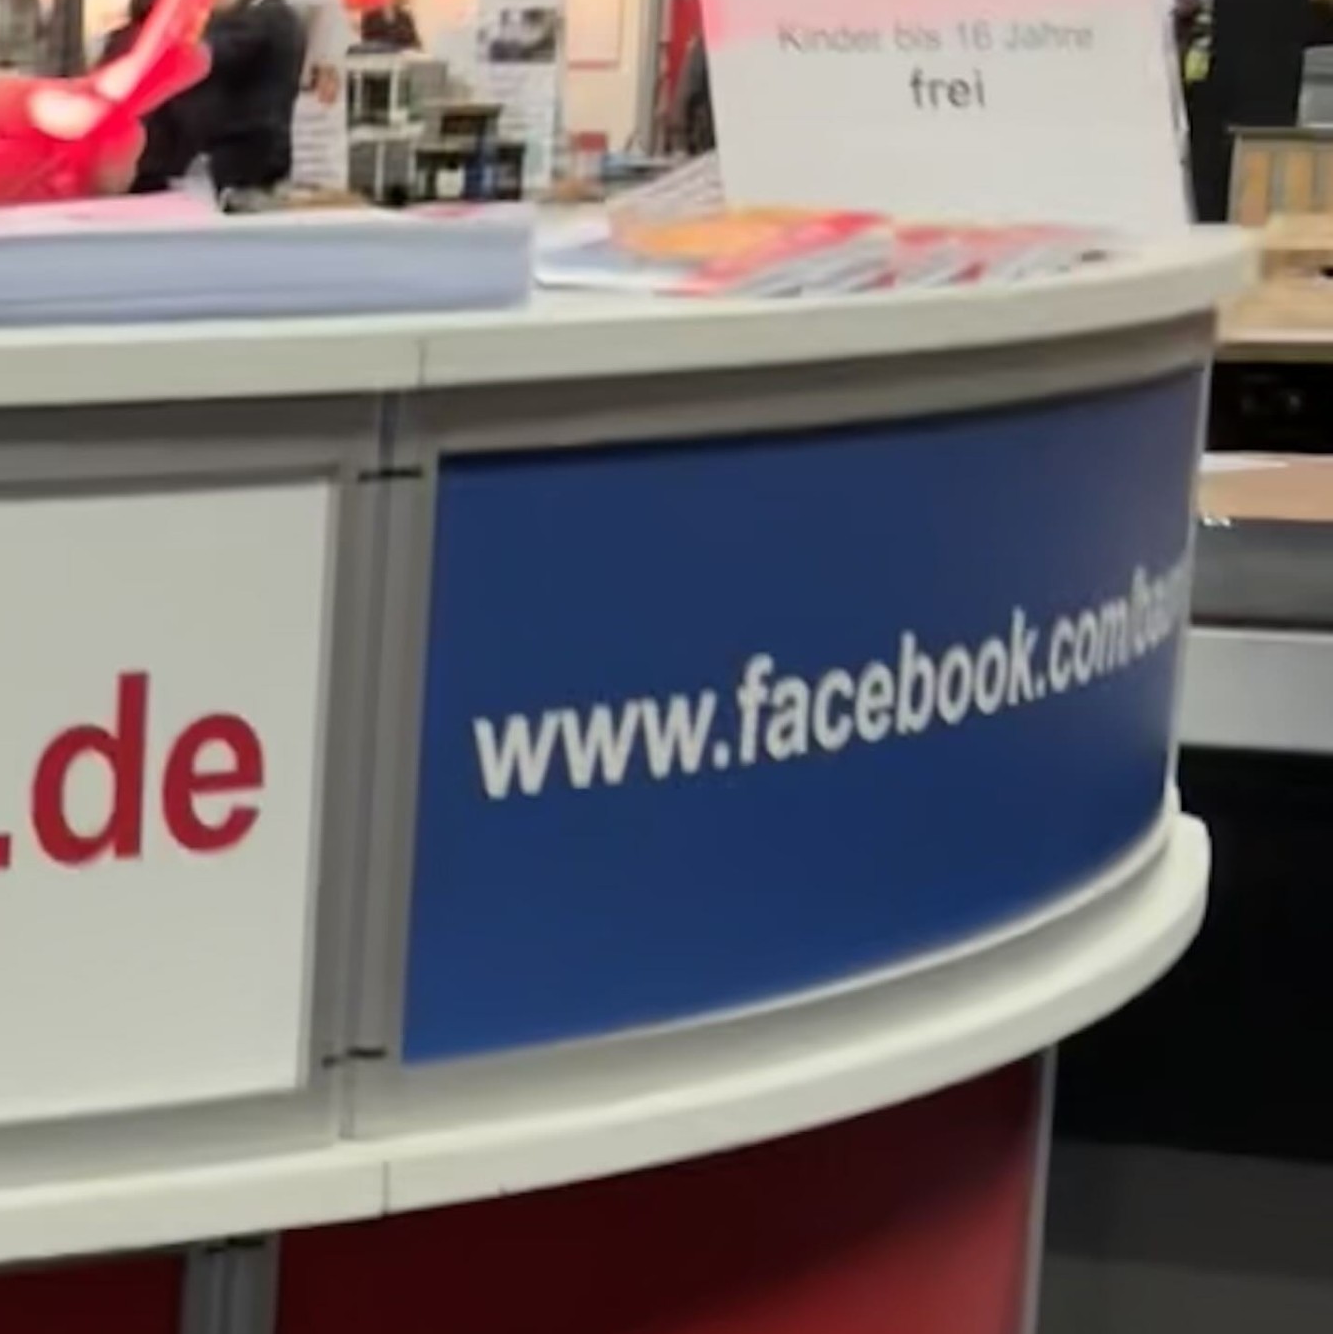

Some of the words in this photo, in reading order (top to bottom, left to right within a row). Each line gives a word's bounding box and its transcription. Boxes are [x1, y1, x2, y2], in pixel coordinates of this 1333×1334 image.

[893, 20, 942, 51] bis
[1003, 20, 1095, 51] Jahre
[909, 65, 986, 108] frei
